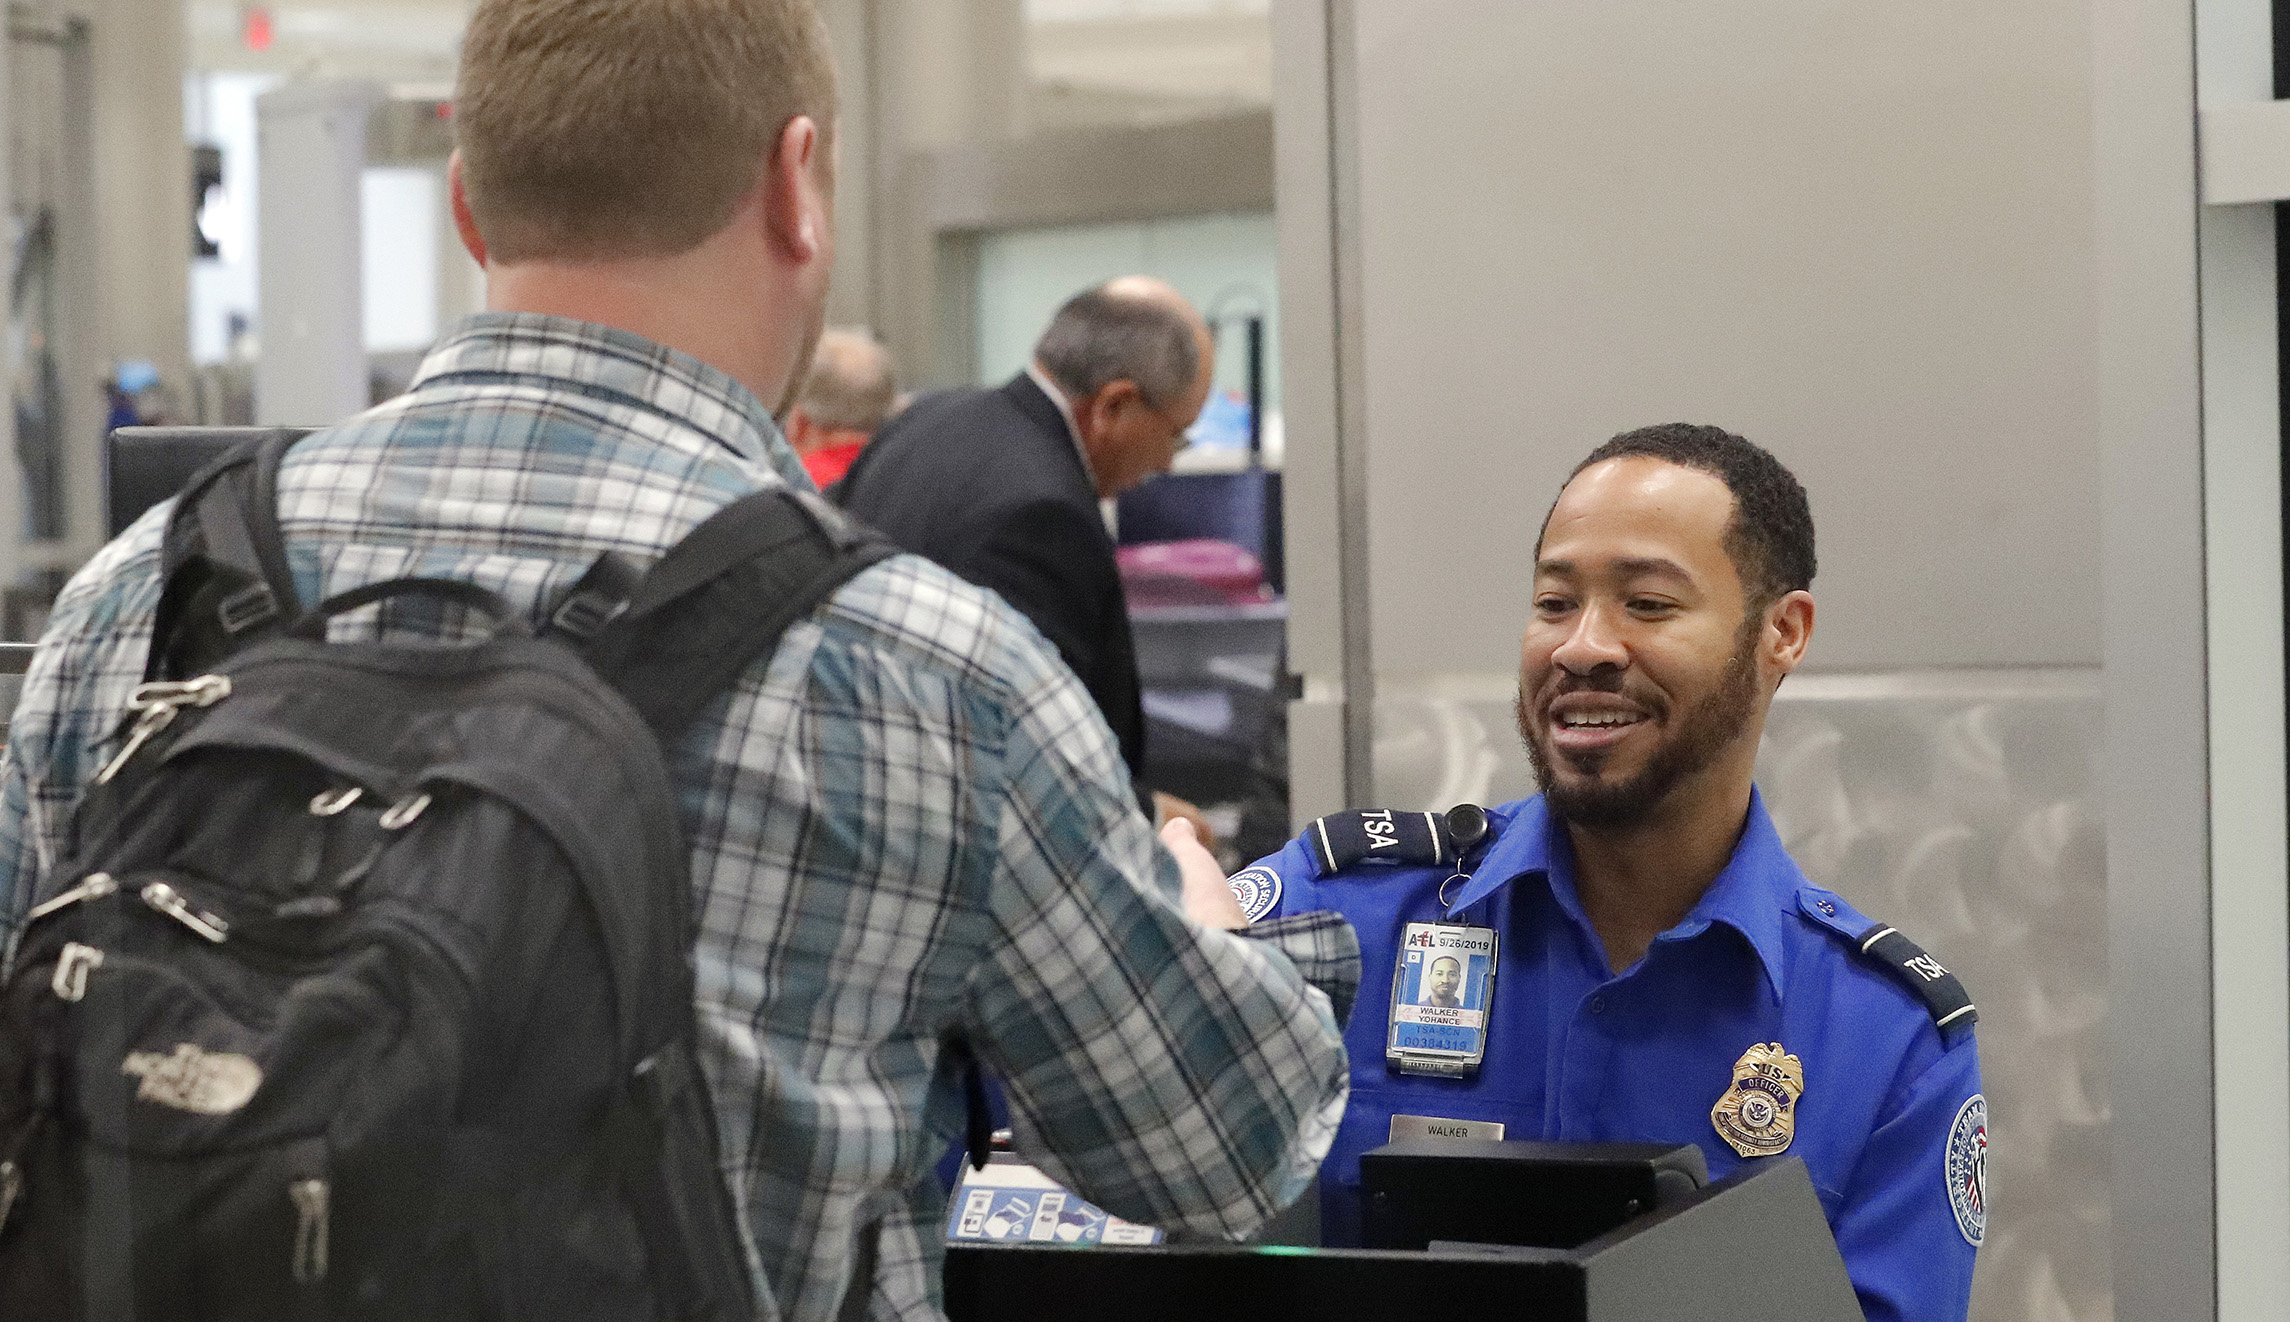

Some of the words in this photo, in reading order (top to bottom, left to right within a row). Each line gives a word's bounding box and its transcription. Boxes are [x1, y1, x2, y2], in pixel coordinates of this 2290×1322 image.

[1361, 809, 1399, 850] TSA
[1439, 937, 1490, 950] 9/26/2019
[1903, 953, 1950, 982] TSA
[1420, 1007, 1459, 1017] WALKER
[1418, 1015, 1461, 1026] YOHANCE
[1761, 1063, 1783, 1080] US
[1748, 1078, 1785, 1099] OFFICER
[1427, 1125, 1469, 1138] WALKER
